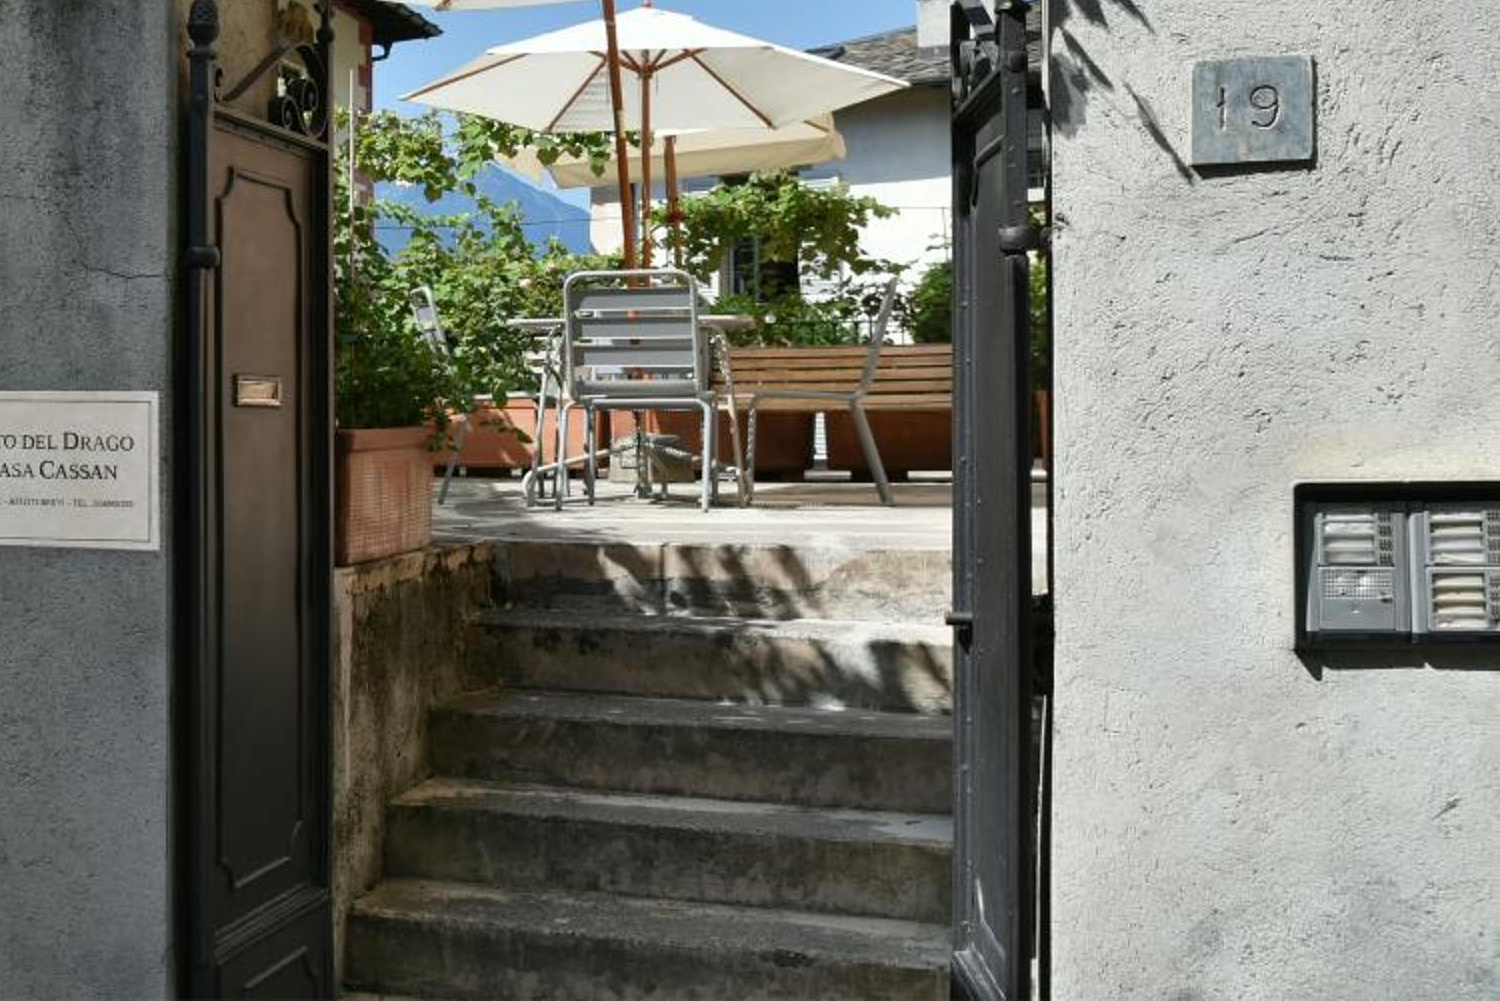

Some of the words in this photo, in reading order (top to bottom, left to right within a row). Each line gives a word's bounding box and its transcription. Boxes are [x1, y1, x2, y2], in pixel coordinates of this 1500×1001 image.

[1216, 84, 1280, 130] 19
[22, 434, 58, 450] DEL
[63, 432, 134, 452] DRAGO
[39, 460, 117, 480] CASSAN
